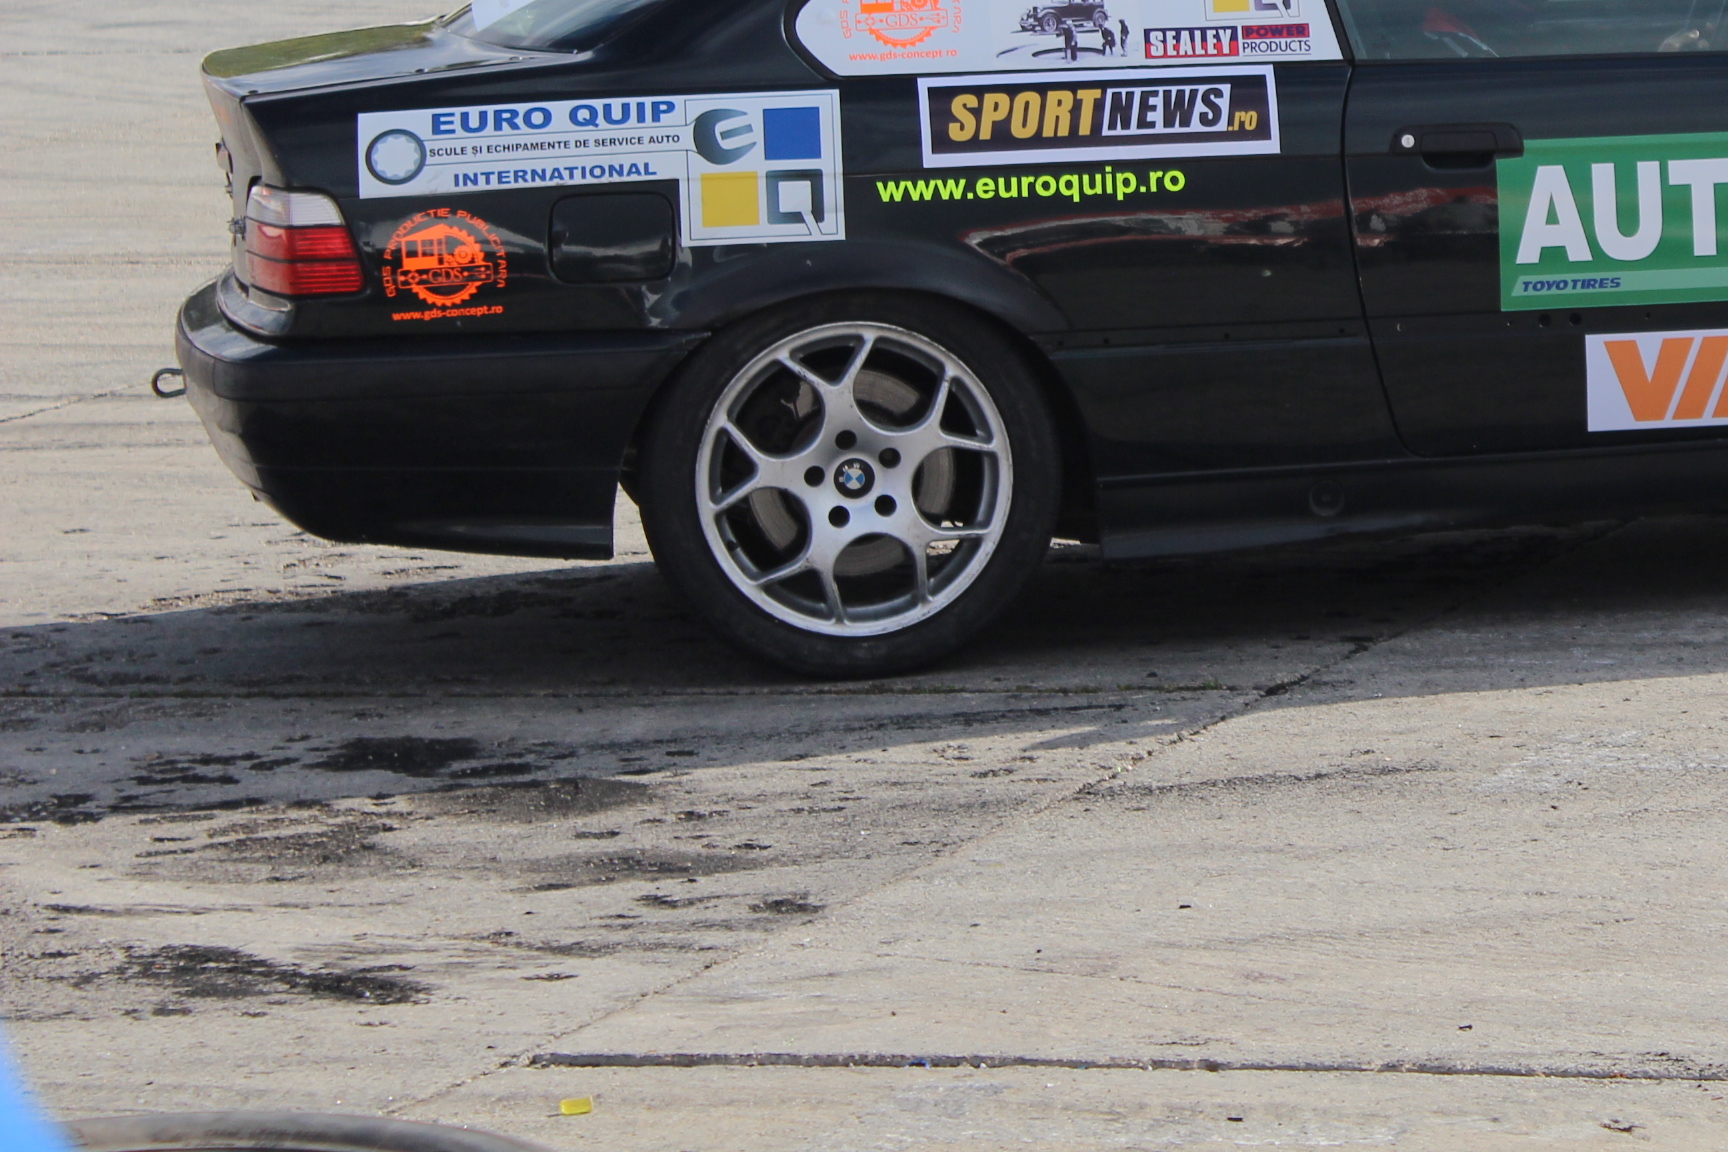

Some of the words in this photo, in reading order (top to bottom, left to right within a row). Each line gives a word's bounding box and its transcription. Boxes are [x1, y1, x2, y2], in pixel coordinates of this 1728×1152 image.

[885, 13, 919, 27] GDS
[1244, 25, 1306, 38] POWER
[1149, 29, 1232, 57] SEALEY
[1242, 39, 1311, 53] PRODUCTS
[431, 107, 552, 136] EURO
[568, 100, 676, 128] QUIP
[429, 147, 468, 157] SCULE
[486, 141, 572, 154] ECHIPAMENTE
[574, 139, 590, 149] DE
[593, 137, 646, 148] SERVICE
[648, 134, 680, 144] AUTO
[454, 162, 657, 187] INTERNATIONAL
[876, 166, 1186, 203] www.euroquip.ro
[384, 208, 451, 260] PRODUCTIE
[382, 266, 396, 297] GDS
[428, 268, 463, 284] GDS
[1522, 280, 1570, 293] TOYO
[1571, 277, 1621, 290] TIRES
[392, 305, 504, 321] www.gds-concept.ro
